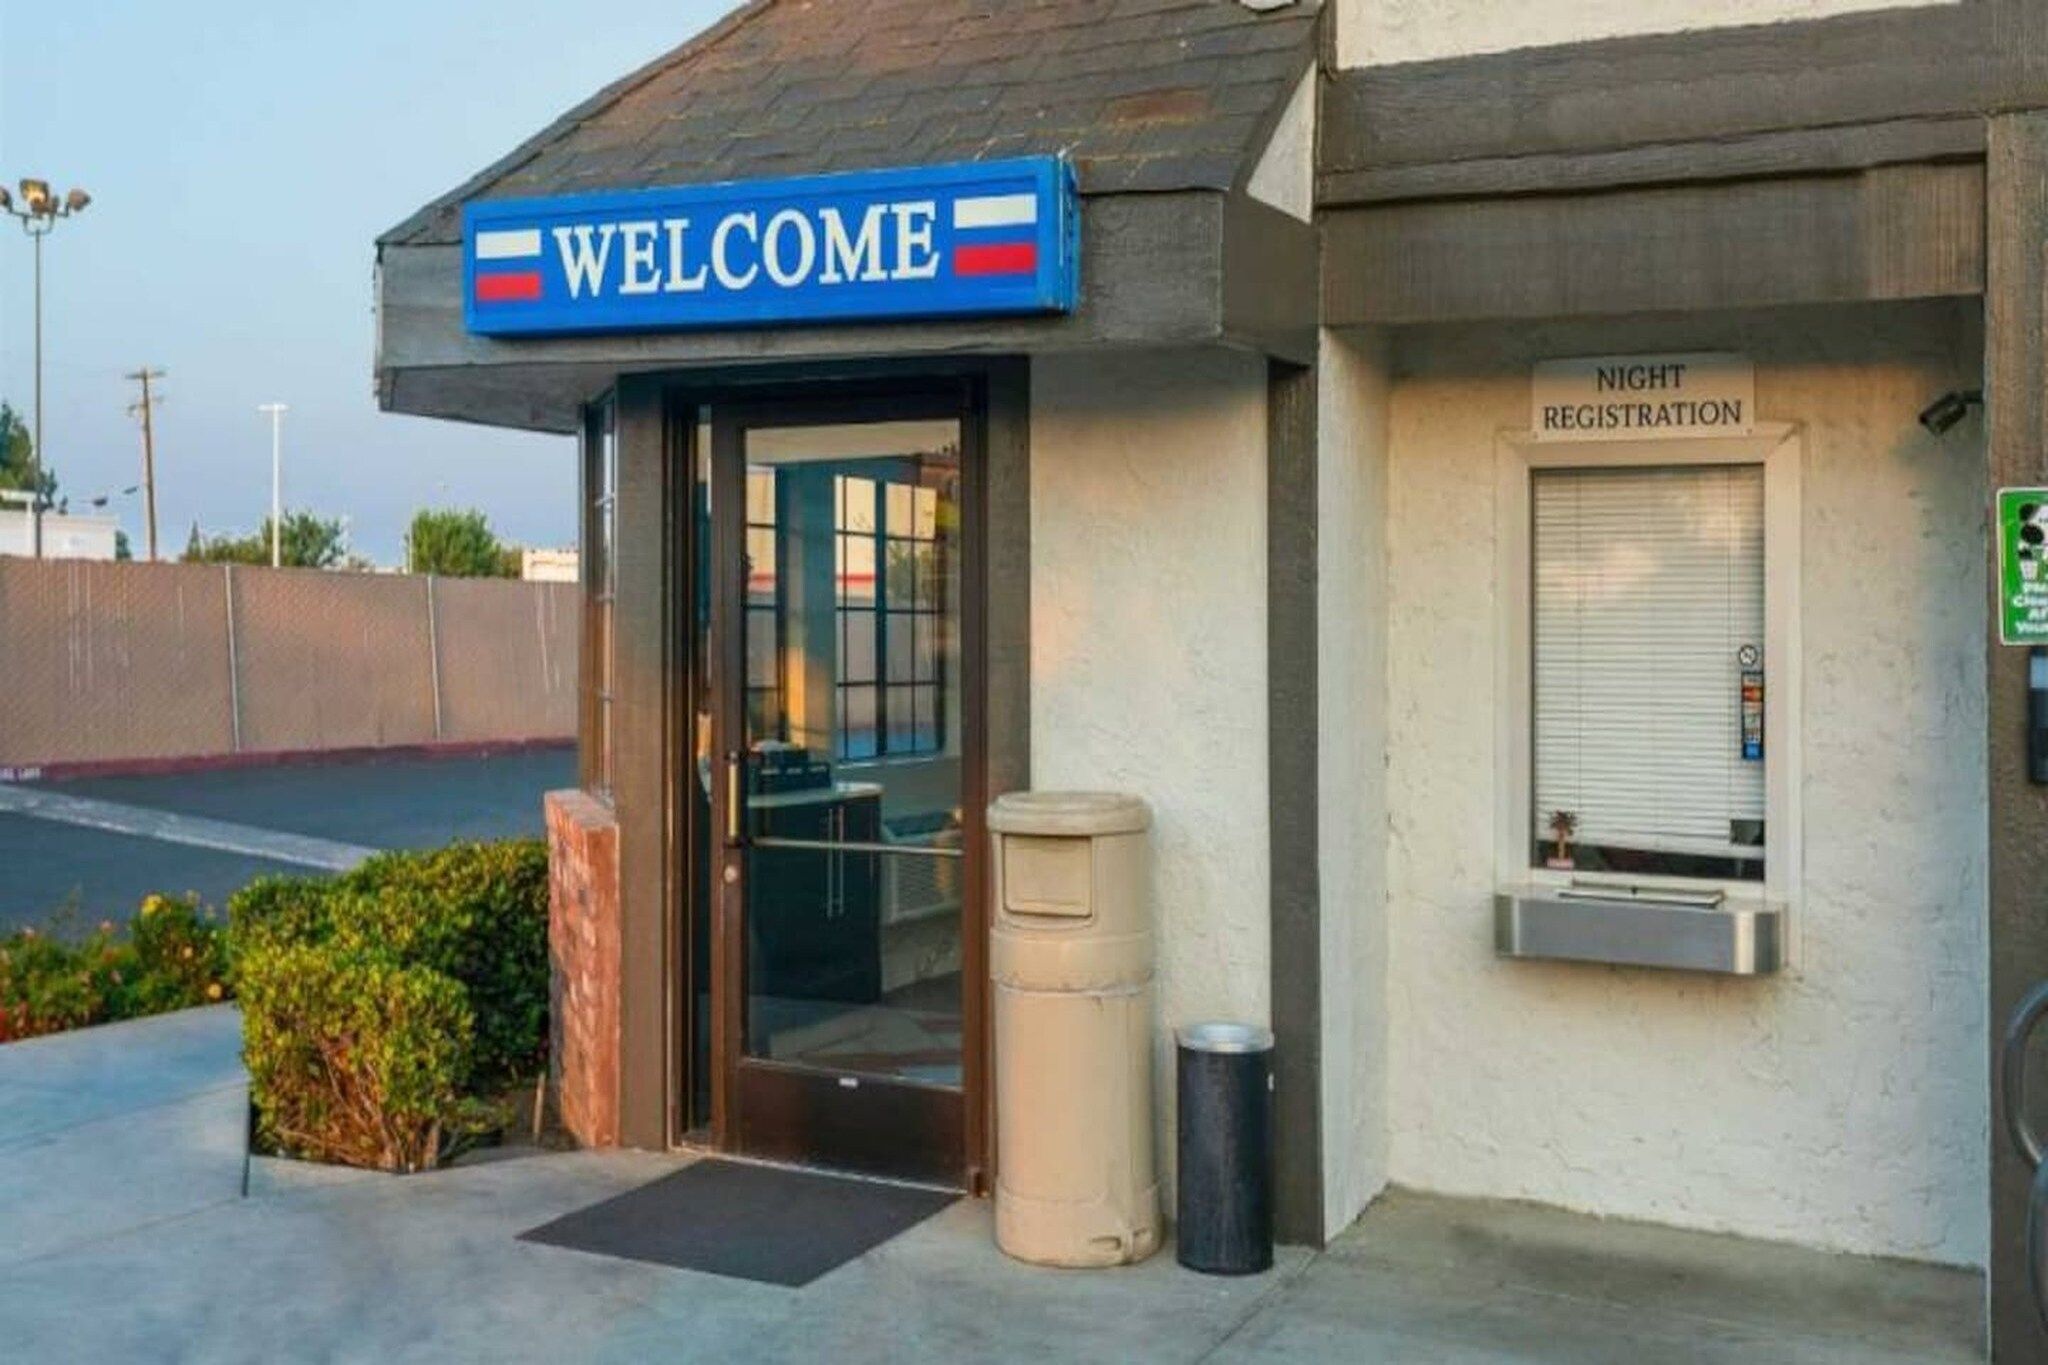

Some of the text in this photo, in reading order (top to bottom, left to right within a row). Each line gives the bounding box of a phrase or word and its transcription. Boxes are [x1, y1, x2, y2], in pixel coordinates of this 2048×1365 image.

[552, 201, 940, 299] WELCOME
[1597, 364, 1686, 391] NIGHT
[1543, 400, 1741, 430] REGISTRATION
